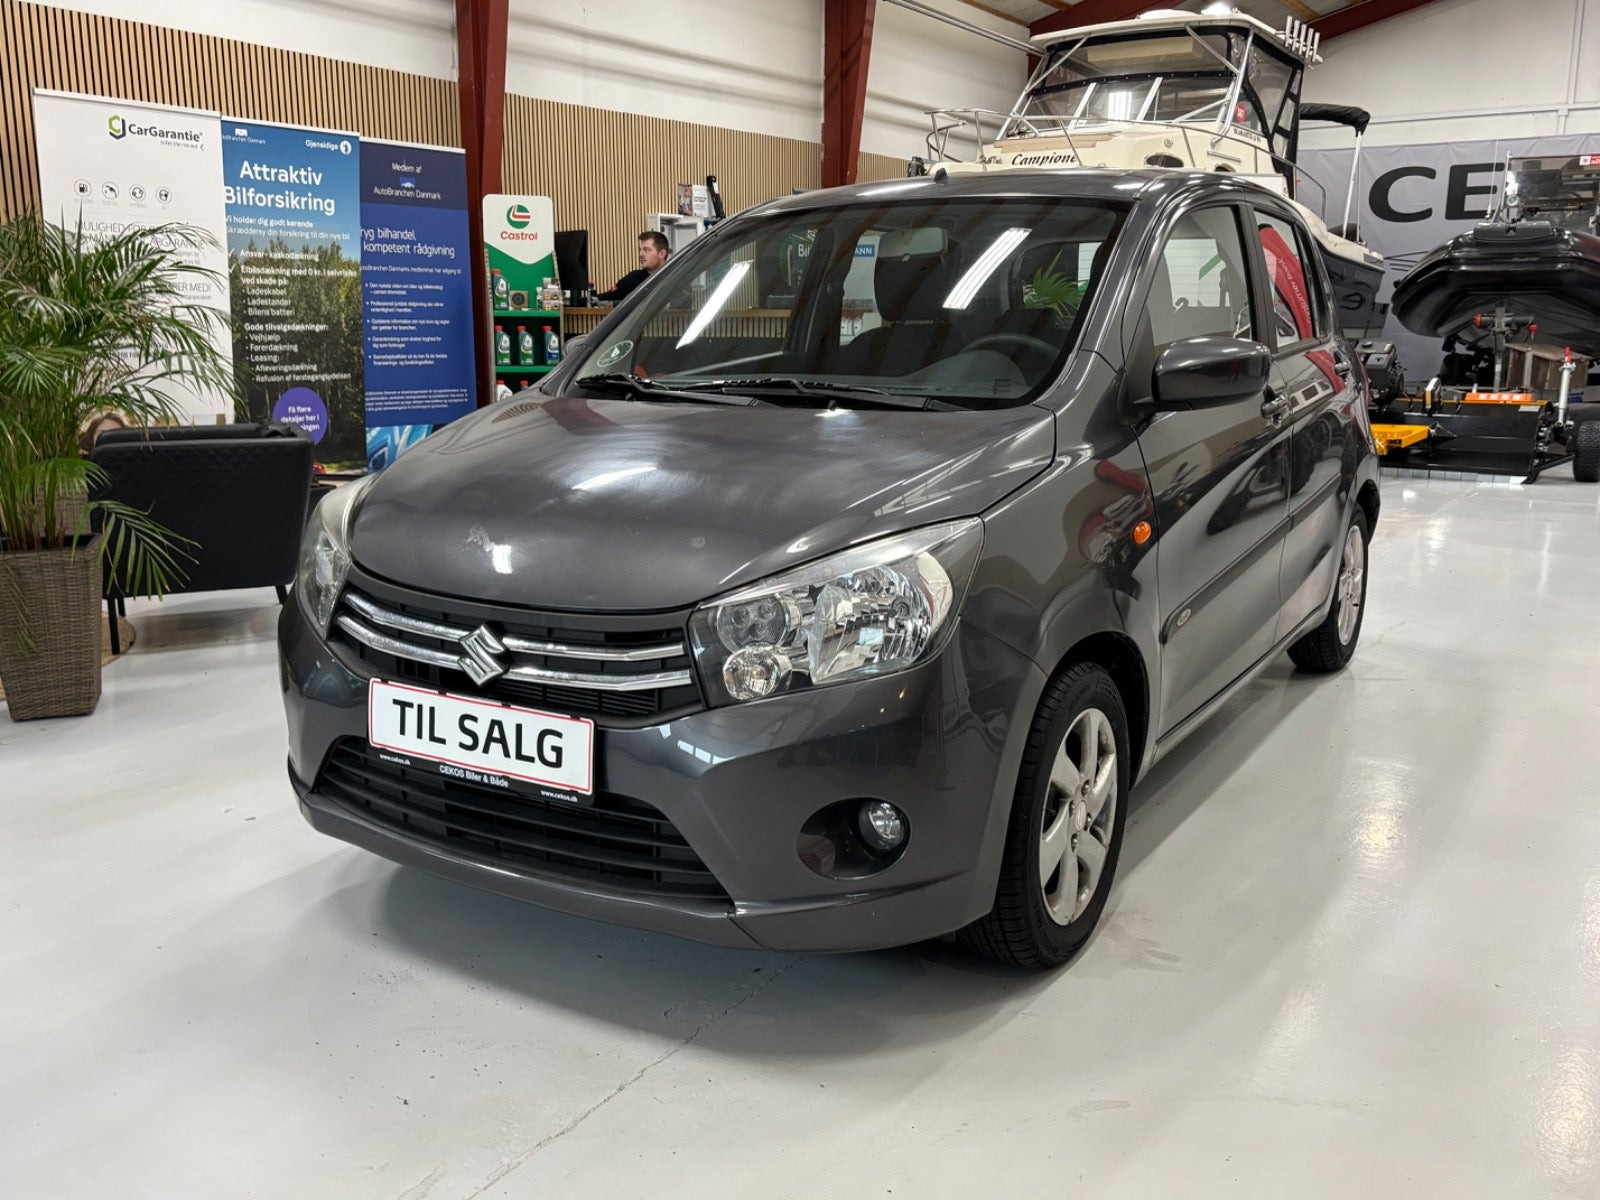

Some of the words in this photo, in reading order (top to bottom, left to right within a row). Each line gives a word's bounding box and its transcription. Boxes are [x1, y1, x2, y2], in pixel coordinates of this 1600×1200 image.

[306, 140, 338, 150] Gjensidige
[392, 161, 414, 172] Medlem
[240, 160, 322, 186] Attraktiv
[373, 186, 415, 198] AutoBranchen
[416, 190, 441, 200] Danmark
[224, 186, 336, 216] Bilforsikring
[233, 215, 256, 224] holder
[258, 218, 268, 226] dig
[270, 218, 286, 227] godt
[360, 228, 374, 241] ryg
[500, 231, 538, 241] Castrol
[364, 241, 410, 254] kompetent
[414, 243, 456, 258] rådgivning
[244, 323, 264, 331] Gode
[256, 374, 284, 382] Refusion
[392, 698, 446, 745] TIL
[458, 714, 564, 769] SALG
[440, 764, 464, 778] CEKOS
[466, 771, 482, 782] Biler
[482, 775, 489, 783] &
[490, 775, 509, 788] Både
[540, 790, 578, 802] www.cekos.dk
